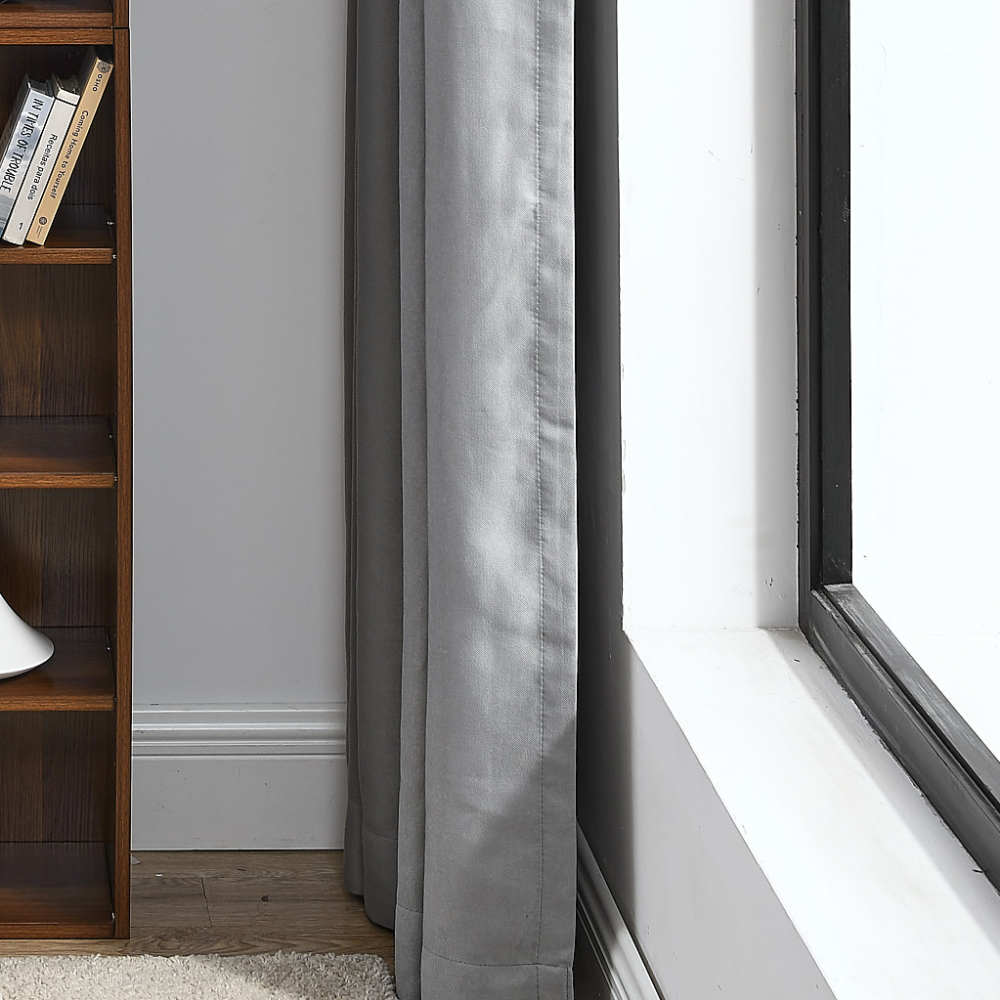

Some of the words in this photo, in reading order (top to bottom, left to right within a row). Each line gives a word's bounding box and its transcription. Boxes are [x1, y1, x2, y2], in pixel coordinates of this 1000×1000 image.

[92, 73, 103, 91] OSHO
[32, 98, 44, 111] IN
[20, 112, 39, 138] TIMES
[72, 110, 89, 137] Coming
[16, 139, 29, 152] OF
[39, 133, 58, 167] Receitas
[64, 138, 78, 159] Home
[0, 152, 24, 193] TROUBLE
[61, 160, 69, 169] to
[33, 166, 44, 184] para
[50, 170, 65, 199] Yourself
[27, 184, 38, 200] dois
